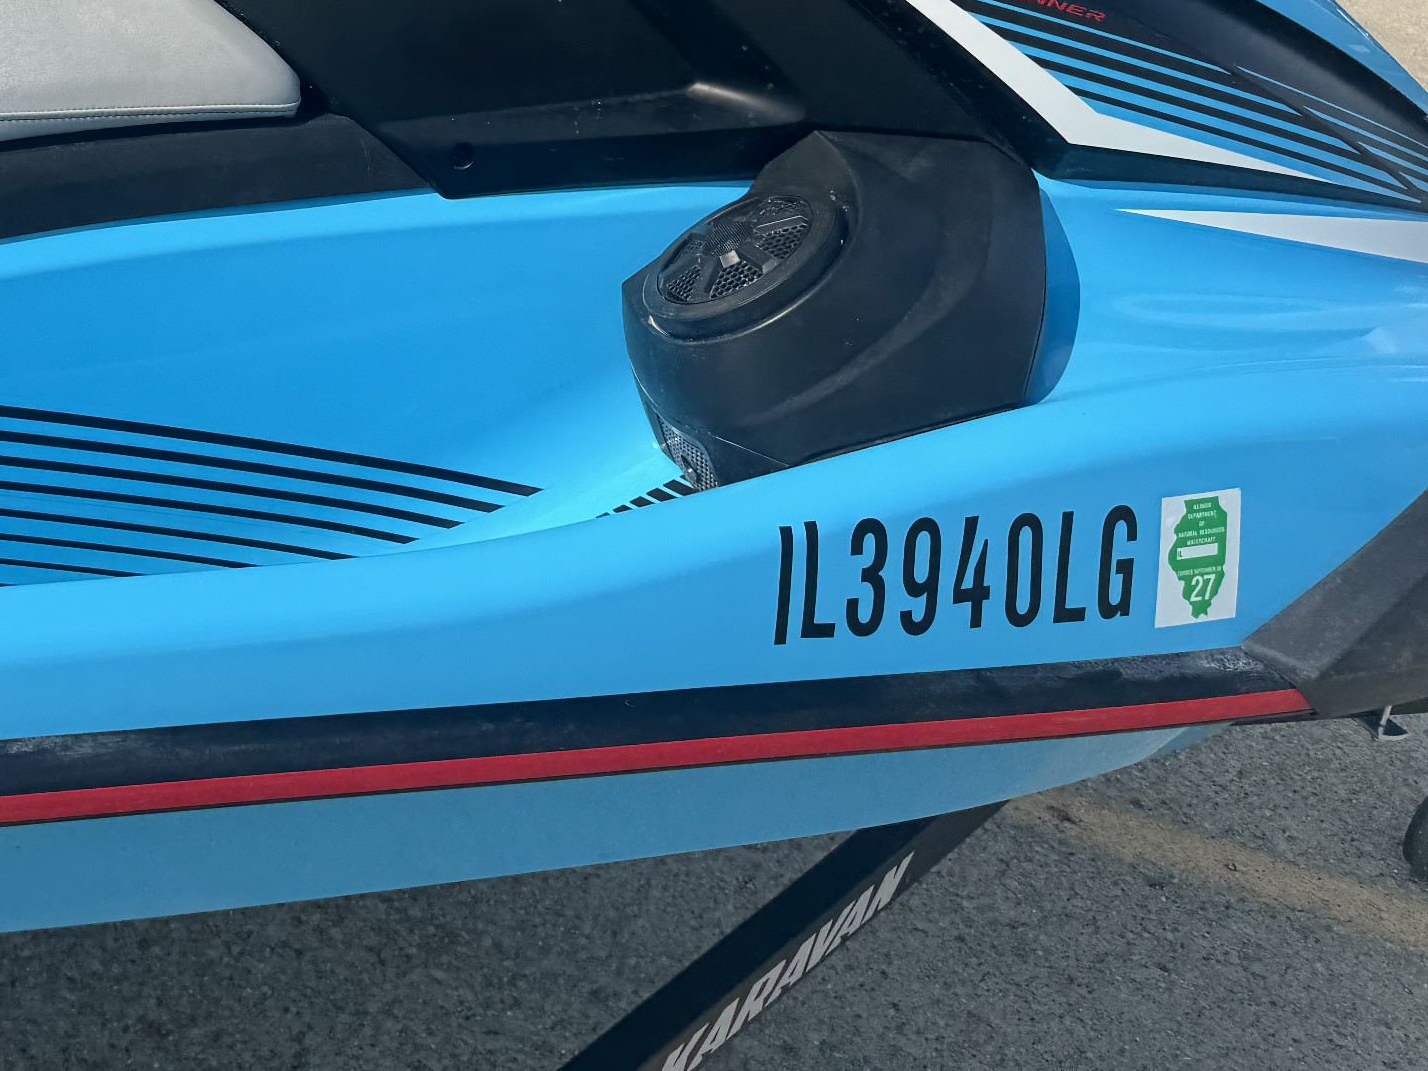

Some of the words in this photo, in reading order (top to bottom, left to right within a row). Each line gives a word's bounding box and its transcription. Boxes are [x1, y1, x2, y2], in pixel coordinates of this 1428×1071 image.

[773, 504, 1138, 646] IL3940LG
[1189, 573, 1216, 602] 27
[661, 849, 915, 1071] KARAVAN
